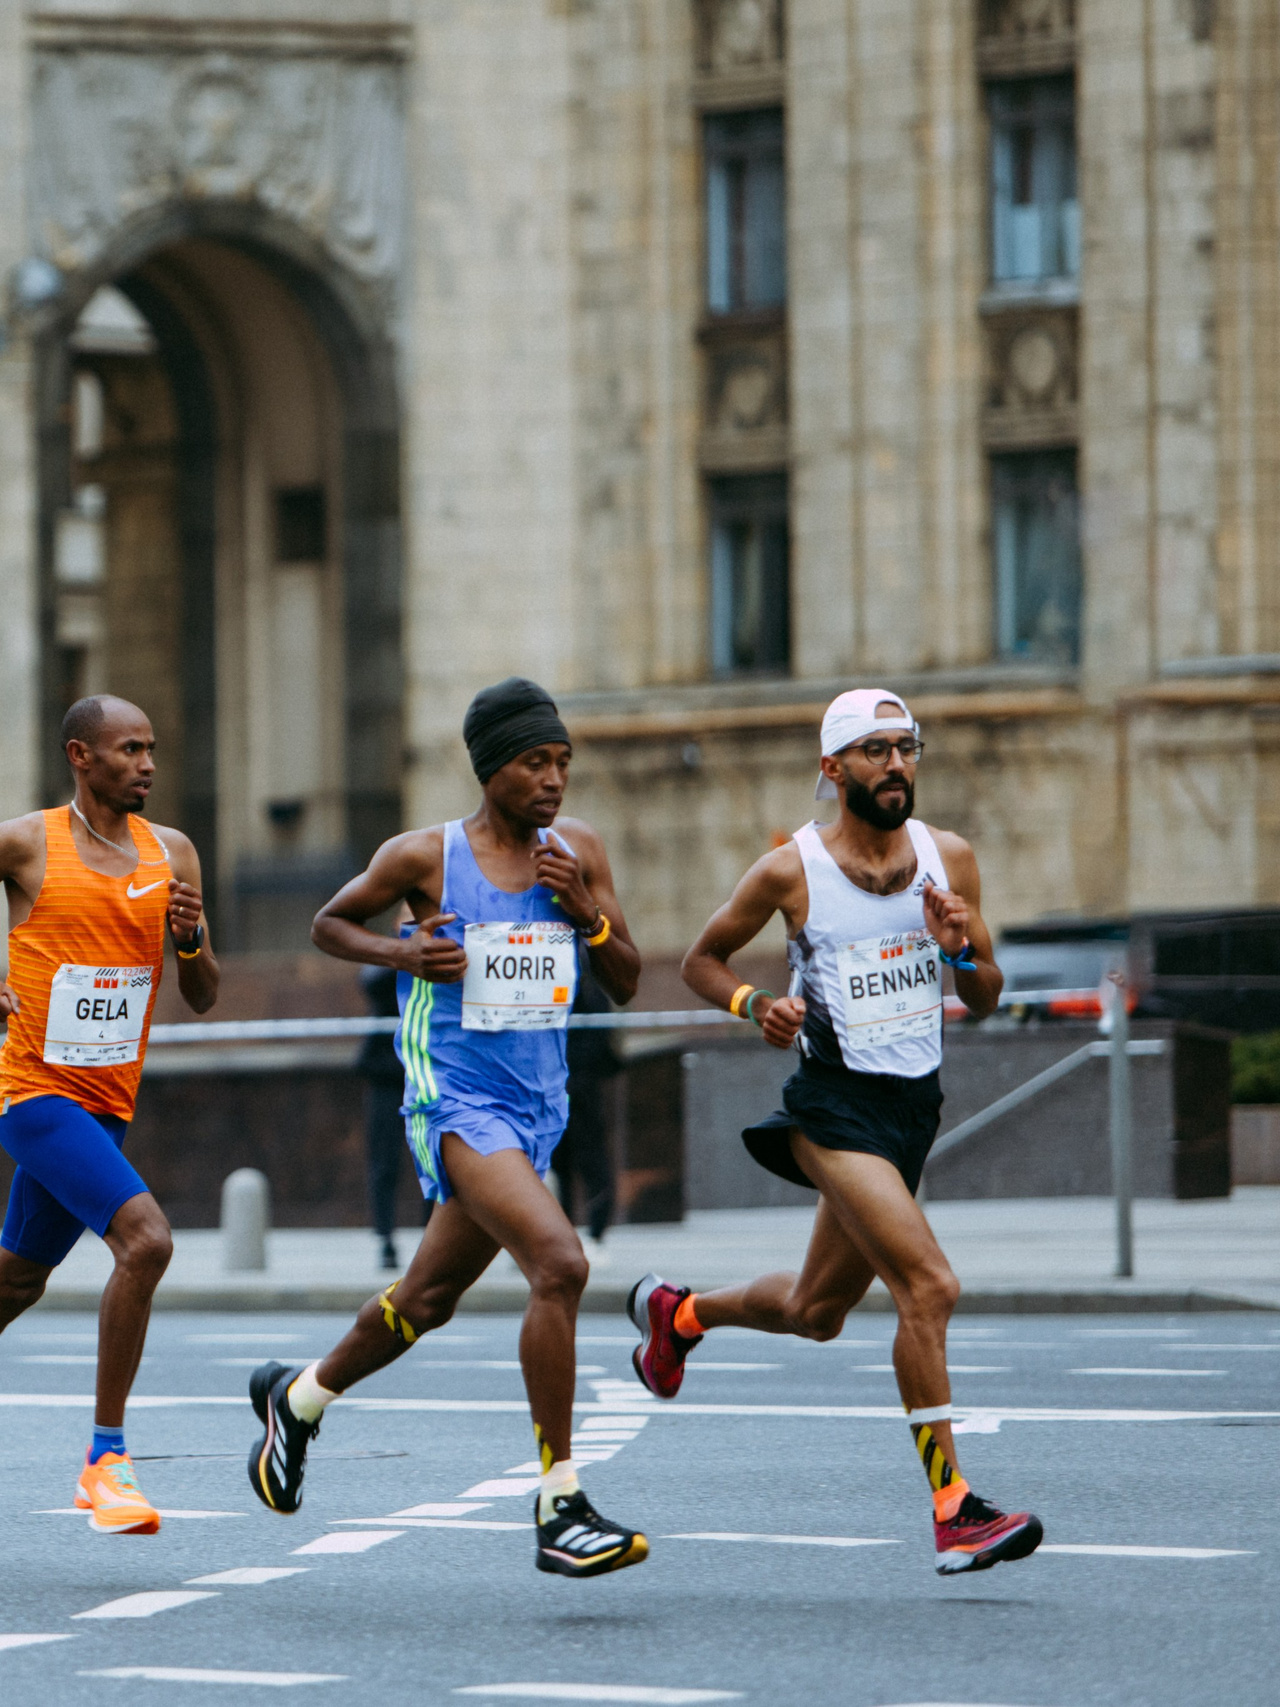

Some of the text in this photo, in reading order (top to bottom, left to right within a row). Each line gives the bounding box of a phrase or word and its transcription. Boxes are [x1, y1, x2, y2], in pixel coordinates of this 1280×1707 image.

[122, 966, 152, 977] 42,2 KM
[486, 954, 555, 980] KORIR
[849, 959, 937, 1000] BENNAR
[514, 991, 525, 1000] 21
[75, 998, 128, 1021] GELA
[895, 1002, 906, 1012] 22
[99, 1031, 104, 1039] 4
